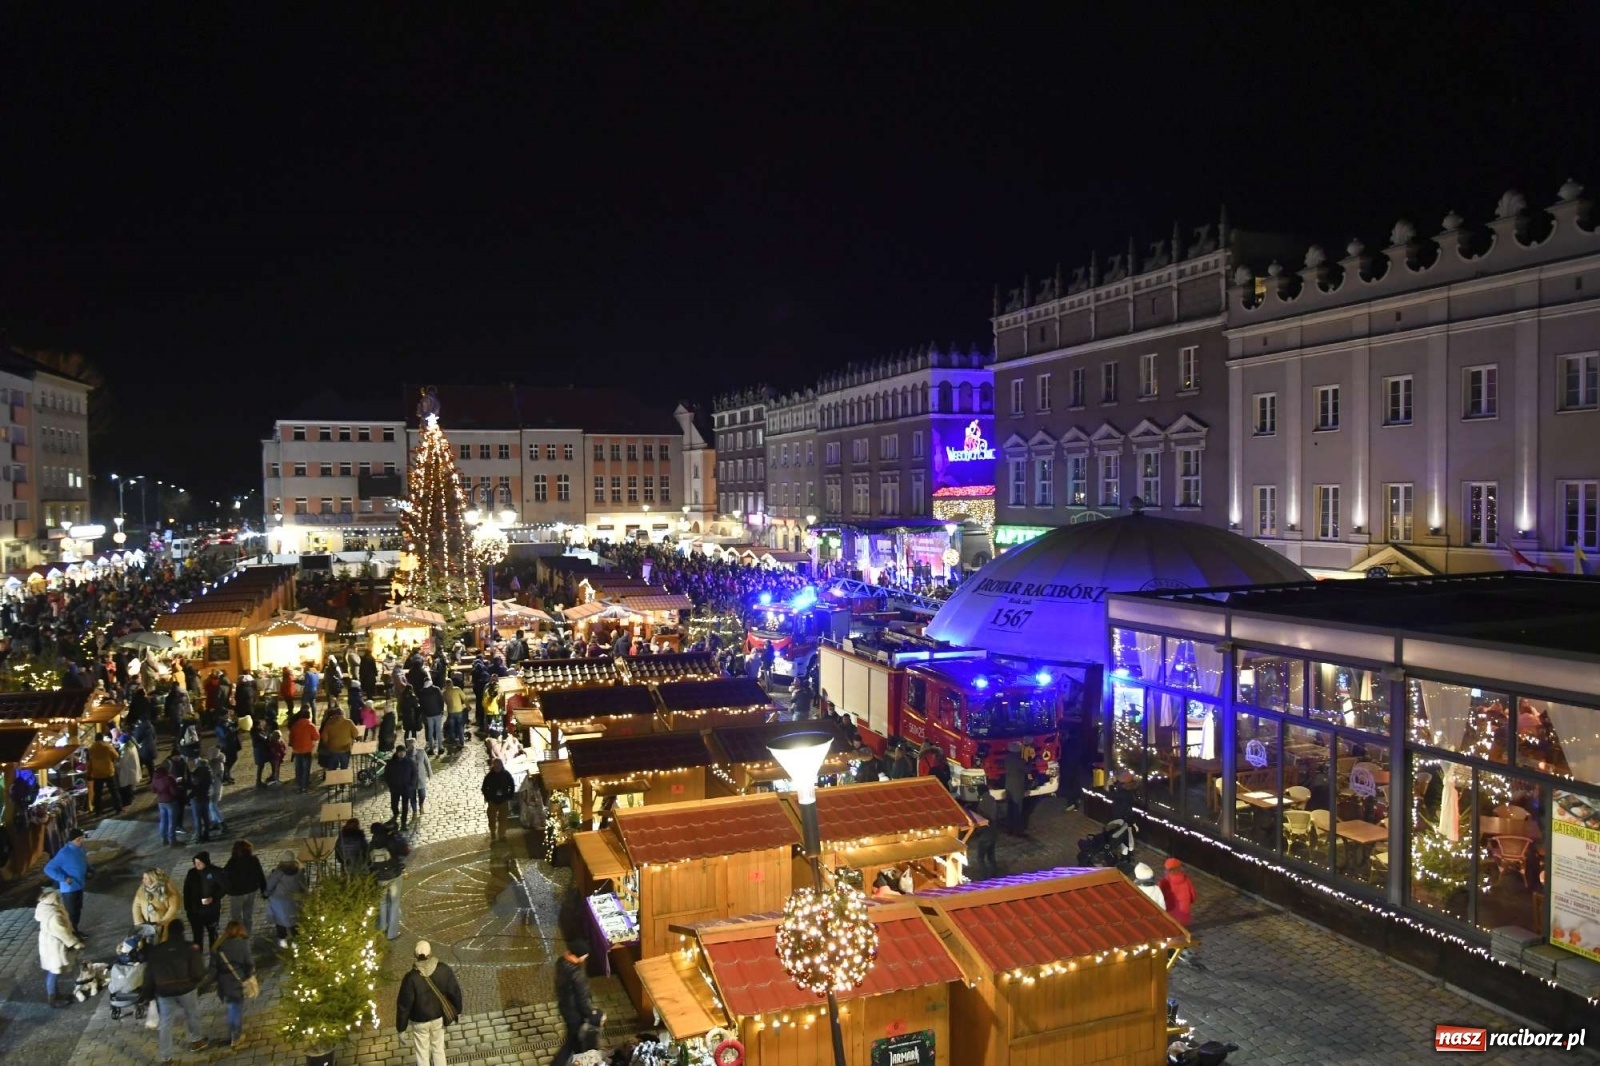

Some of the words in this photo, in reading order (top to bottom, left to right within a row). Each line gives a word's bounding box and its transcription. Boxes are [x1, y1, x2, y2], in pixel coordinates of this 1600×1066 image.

[1020, 583, 1109, 603] RACIBÓRZ
[990, 608, 1033, 629] 1567
[1553, 821, 1585, 839] CATERING
[1585, 842, 1597, 852] BEZ
[888, 1046, 920, 1066] JARMARK
